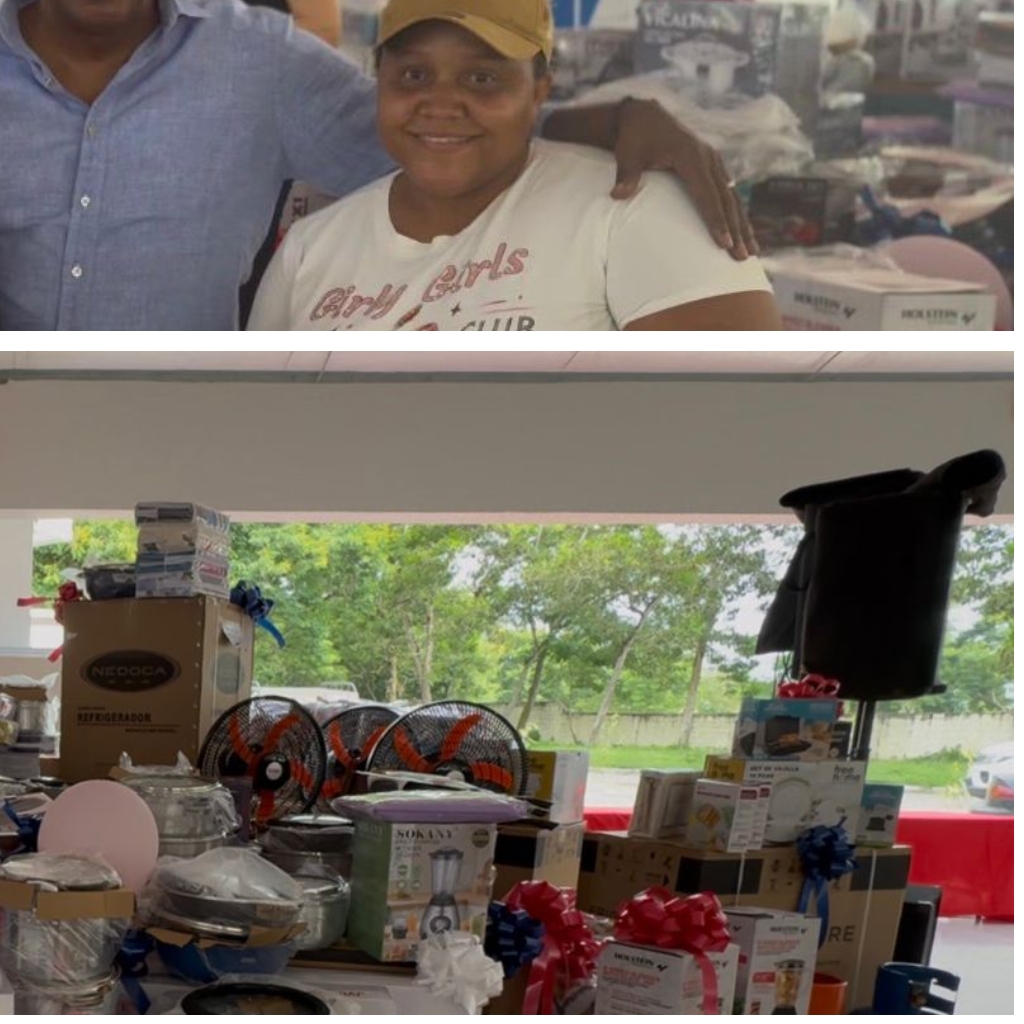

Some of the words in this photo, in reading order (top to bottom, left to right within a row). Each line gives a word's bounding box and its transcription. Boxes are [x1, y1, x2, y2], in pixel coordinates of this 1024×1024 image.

[309, 283, 409, 322] Girly
[422, 242, 528, 303] Girls
[78, 712, 152, 723] REFRIGERADOR
[397, 828, 453, 840] SOKANY
